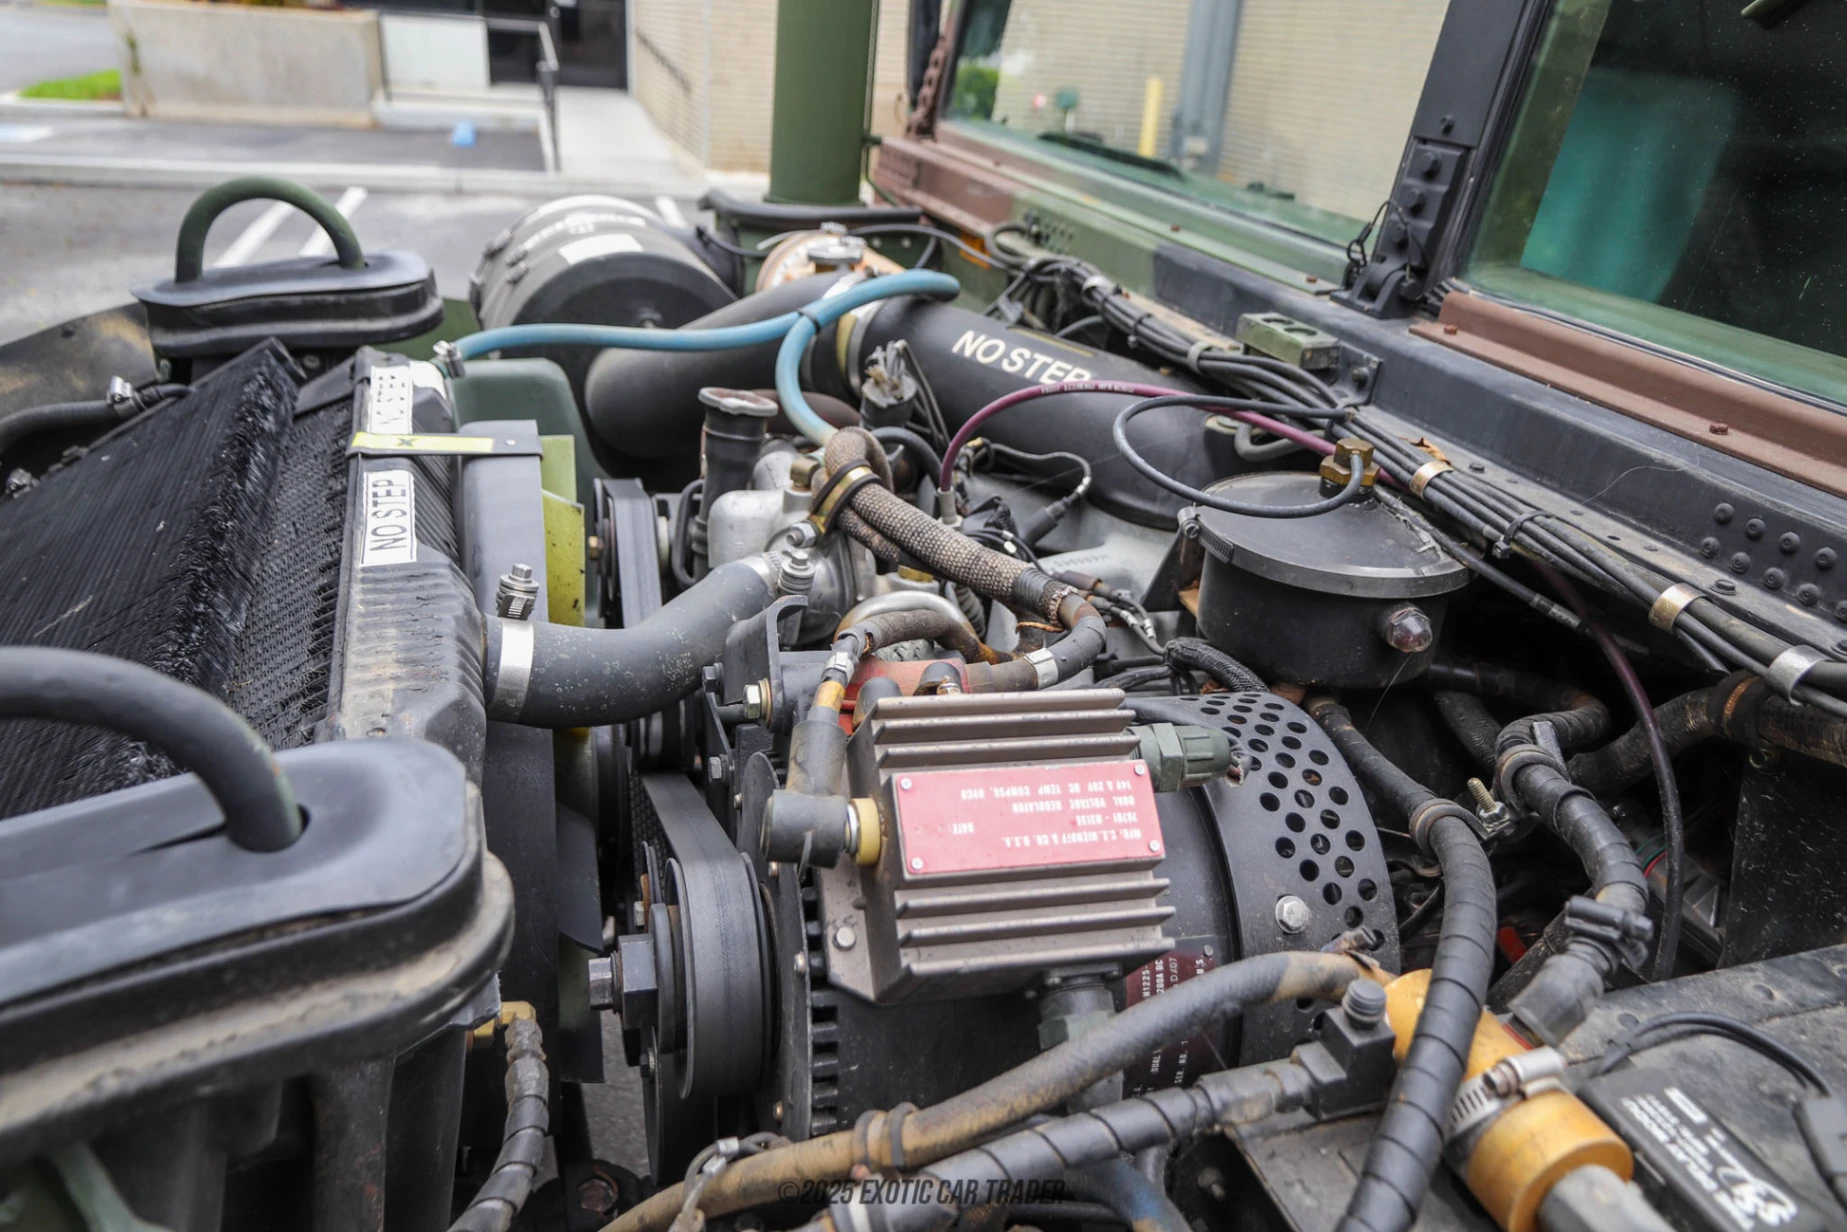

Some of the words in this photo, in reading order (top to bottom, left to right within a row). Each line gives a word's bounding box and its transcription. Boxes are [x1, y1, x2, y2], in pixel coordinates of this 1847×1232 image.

[952, 330, 1006, 364] NO
[1001, 347, 1093, 385] STEP
[372, 479, 407, 519] STEP
[370, 524, 407, 551] NO
[1037, 783, 1062, 794] TEMP
[1012, 800, 1062, 813] REGULATOR
[1069, 797, 1106, 809] VOLTAGE
[1113, 795, 1135, 806] DUAL
[1001, 835, 1030, 848] U.S.A.
[1033, 834, 1049, 845] CO.
[1174, 1068, 1185, 1084] SER.
